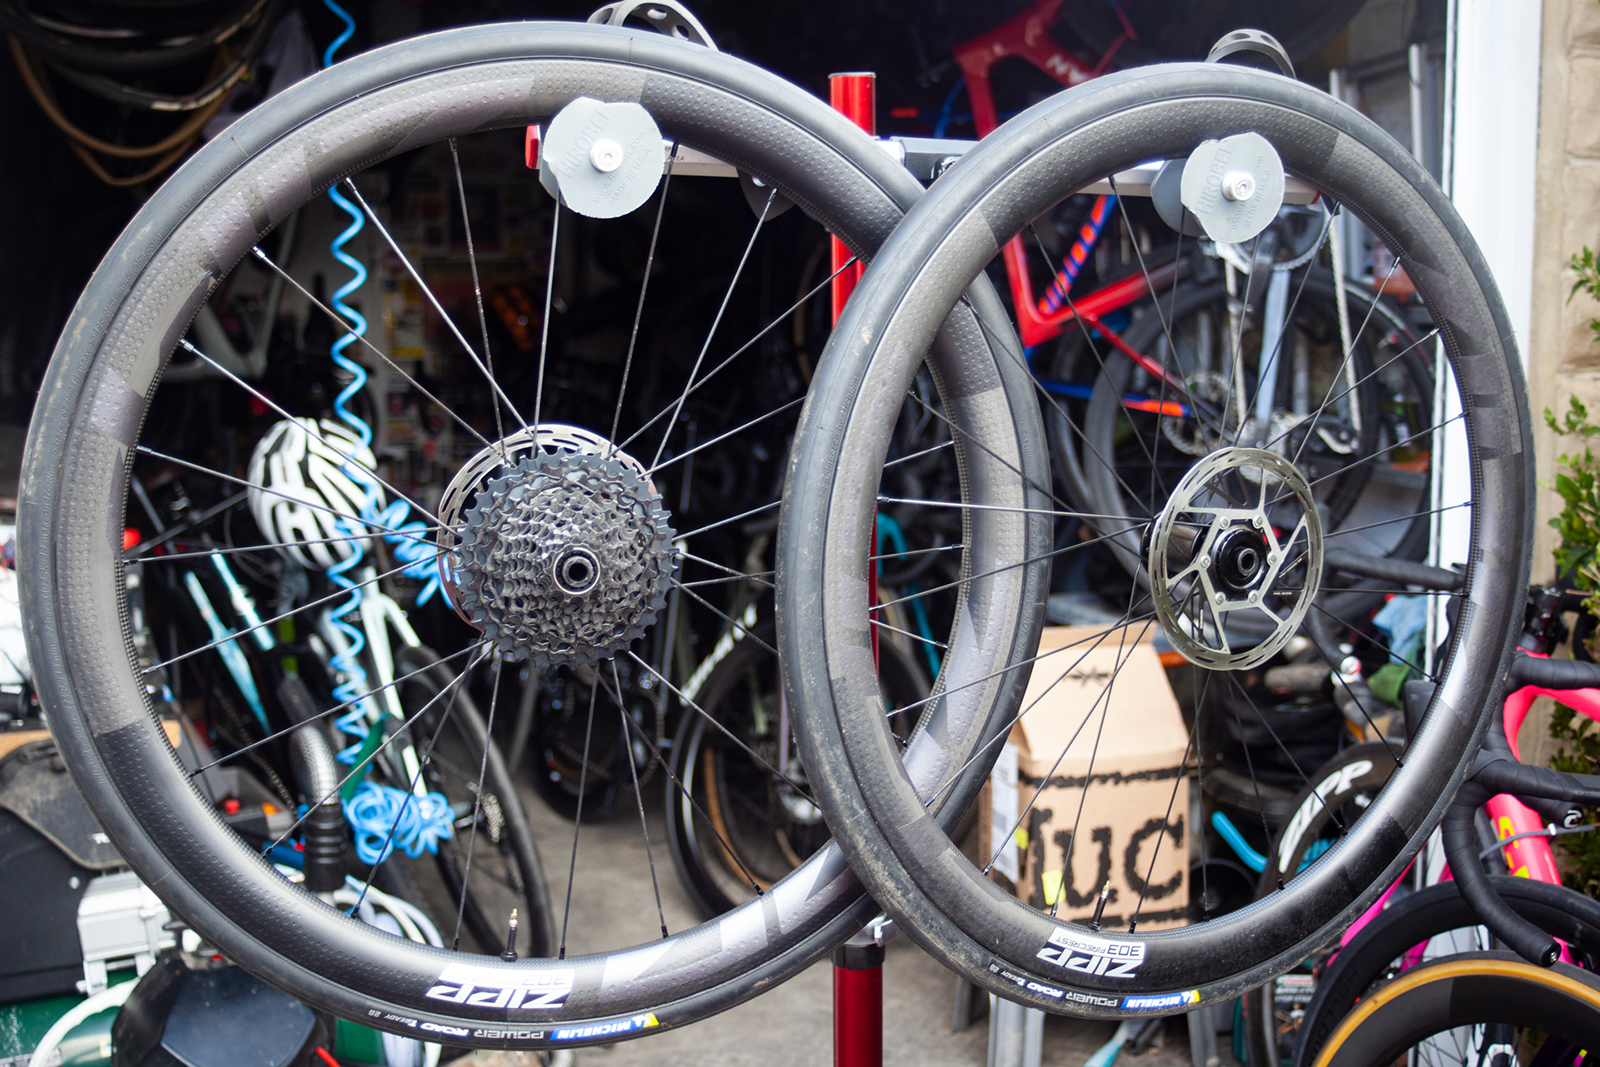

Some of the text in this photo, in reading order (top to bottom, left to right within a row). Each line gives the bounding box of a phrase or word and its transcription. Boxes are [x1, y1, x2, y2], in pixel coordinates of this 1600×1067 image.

[556, 109, 613, 179] HIROBEL
[608, 147, 653, 208] MADE IN U.S.A.
[1196, 144, 1234, 216] HIROBEL
[1245, 206, 1256, 229] MADE
[1260, 167, 1273, 192] U.S.A.
[1278, 760, 1373, 873] ZIPP
[1055, 936, 1142, 957] 303 FIRECREST
[1036, 947, 1143, 978] ZIPP
[523, 974, 569, 986] 303
[1027, 982, 1064, 998] ROAD
[426, 984, 571, 1009] ZIPP
[1066, 992, 1118, 1007] POWER
[1126, 995, 1180, 1008] MICHELIN
[420, 1021, 470, 1038] ROAD
[474, 1030, 544, 1041] POWER
[555, 1020, 632, 1039] MICHELIN
